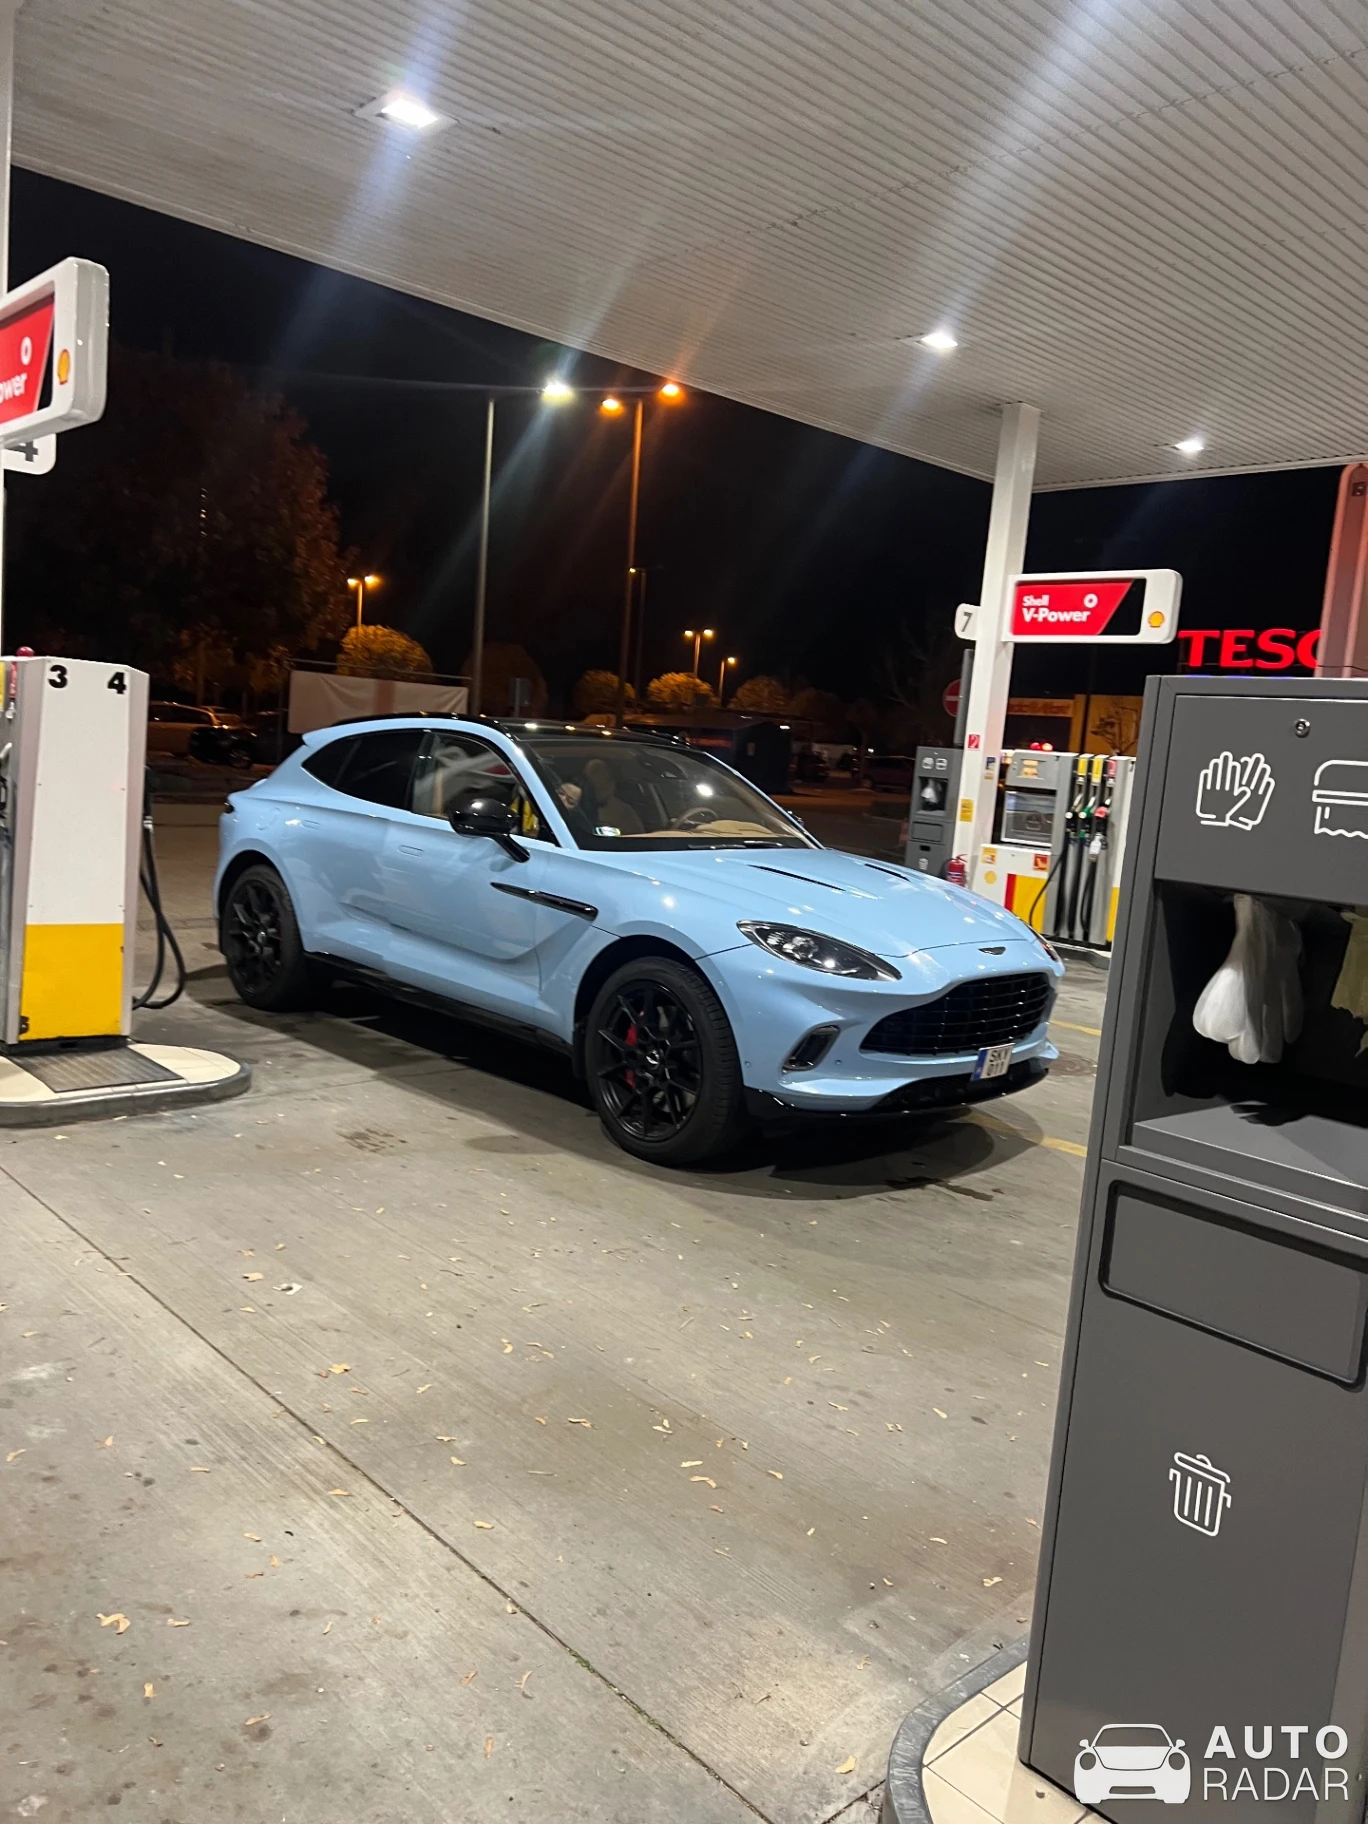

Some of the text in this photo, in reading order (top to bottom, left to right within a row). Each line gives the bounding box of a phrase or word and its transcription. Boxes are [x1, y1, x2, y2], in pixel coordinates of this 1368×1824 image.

[6, 440, 39, 463] 4
[1022, 595, 1050, 607] Shell
[962, 611, 973, 633] 7
[1022, 607, 1091, 623] V-Power
[1178, 628, 1322, 670] TESC
[48, 664, 127, 695] 3 4
